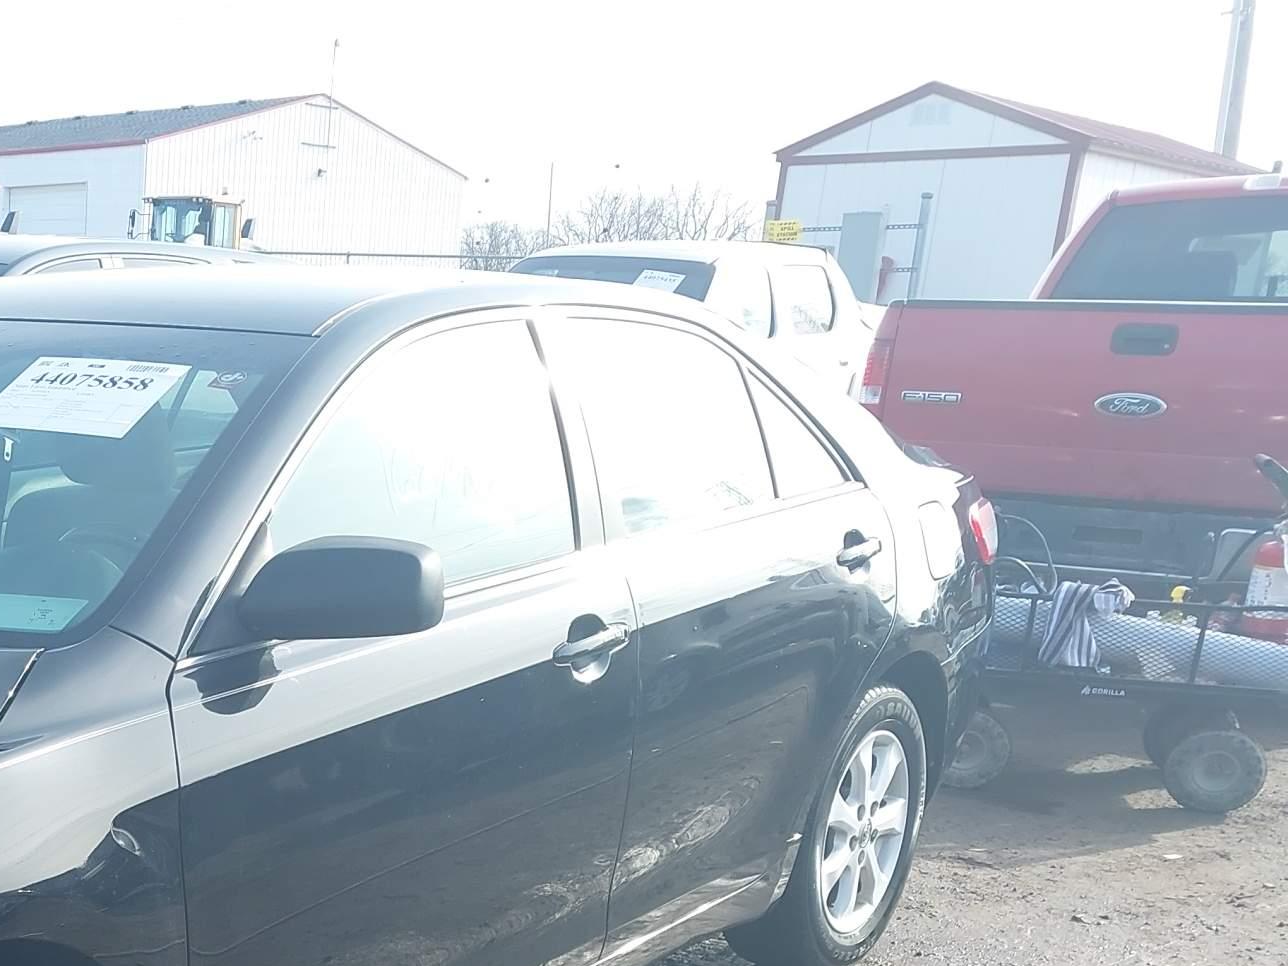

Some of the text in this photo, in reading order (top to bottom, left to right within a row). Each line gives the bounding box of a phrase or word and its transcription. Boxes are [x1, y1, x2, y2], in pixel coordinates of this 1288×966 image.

[30, 372, 154, 391] 44075858
[1110, 397, 1150, 413] Ford
[1091, 687, 1125, 696] GORILLA
